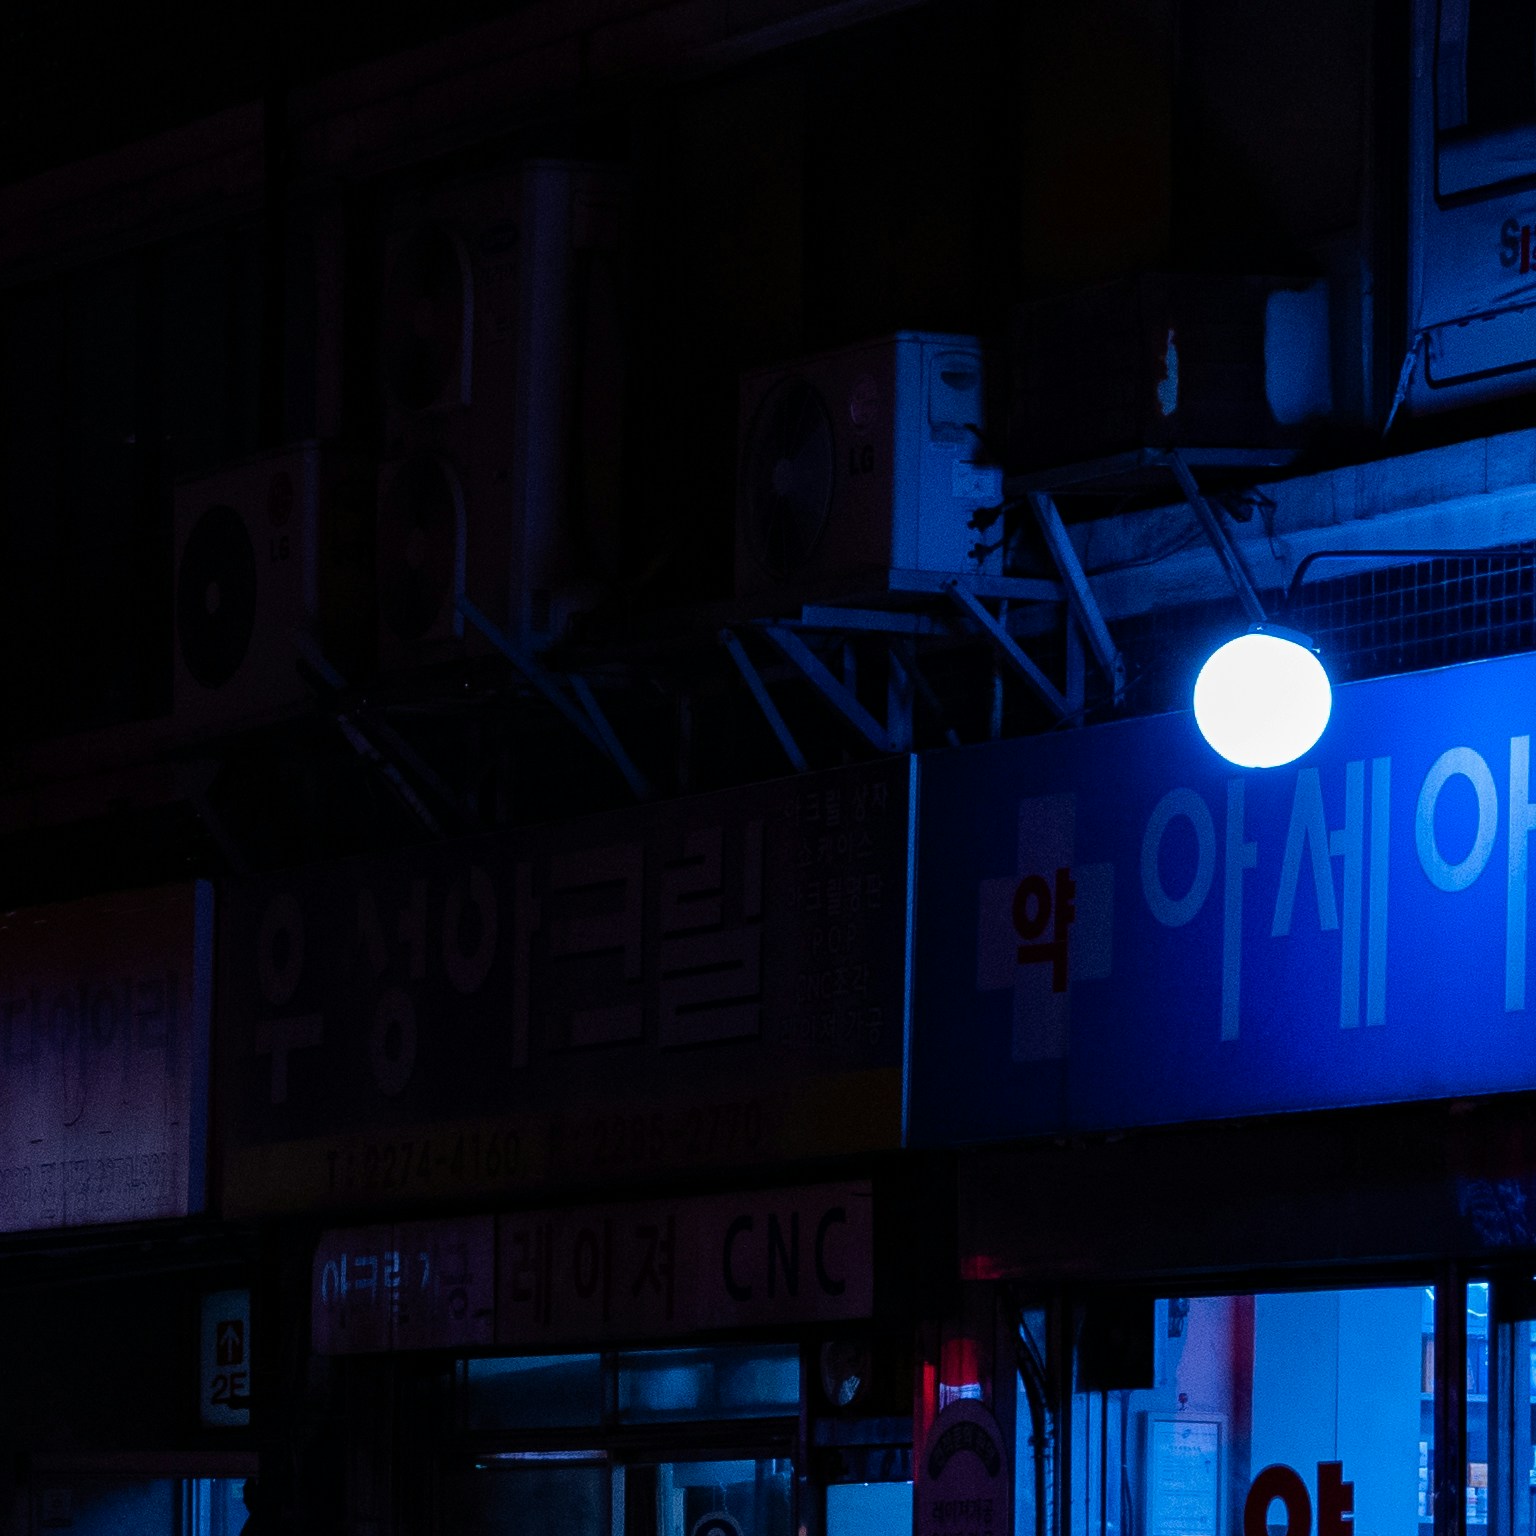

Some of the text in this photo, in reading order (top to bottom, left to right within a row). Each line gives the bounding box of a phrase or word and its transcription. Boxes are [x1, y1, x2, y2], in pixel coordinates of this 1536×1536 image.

[847, 445, 875, 476] LG
[253, 818, 767, 1103] 우성아크릴
[1011, 868, 1077, 994] 약
[721, 1207, 847, 1302] CNC
